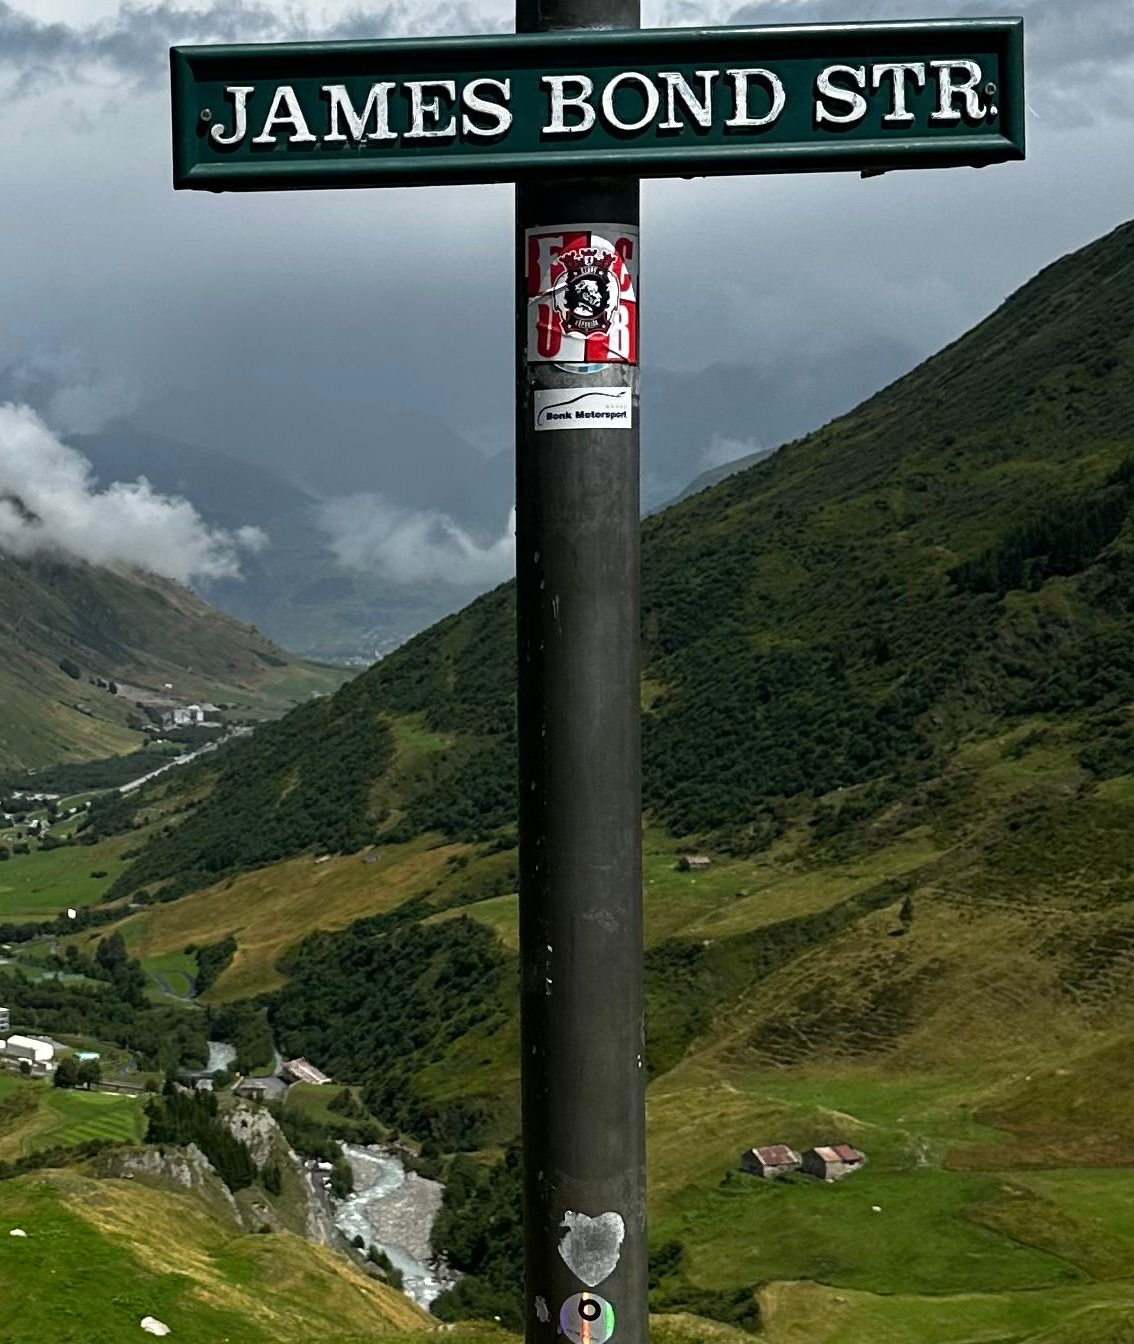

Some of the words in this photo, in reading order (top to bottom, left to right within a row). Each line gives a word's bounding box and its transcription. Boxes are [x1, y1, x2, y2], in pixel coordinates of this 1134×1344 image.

[211, 76, 514, 145] JAMES
[540, 67, 786, 133] BOND
[816, 59, 999, 124] STR.
[575, 410, 627, 420] Motorsport
